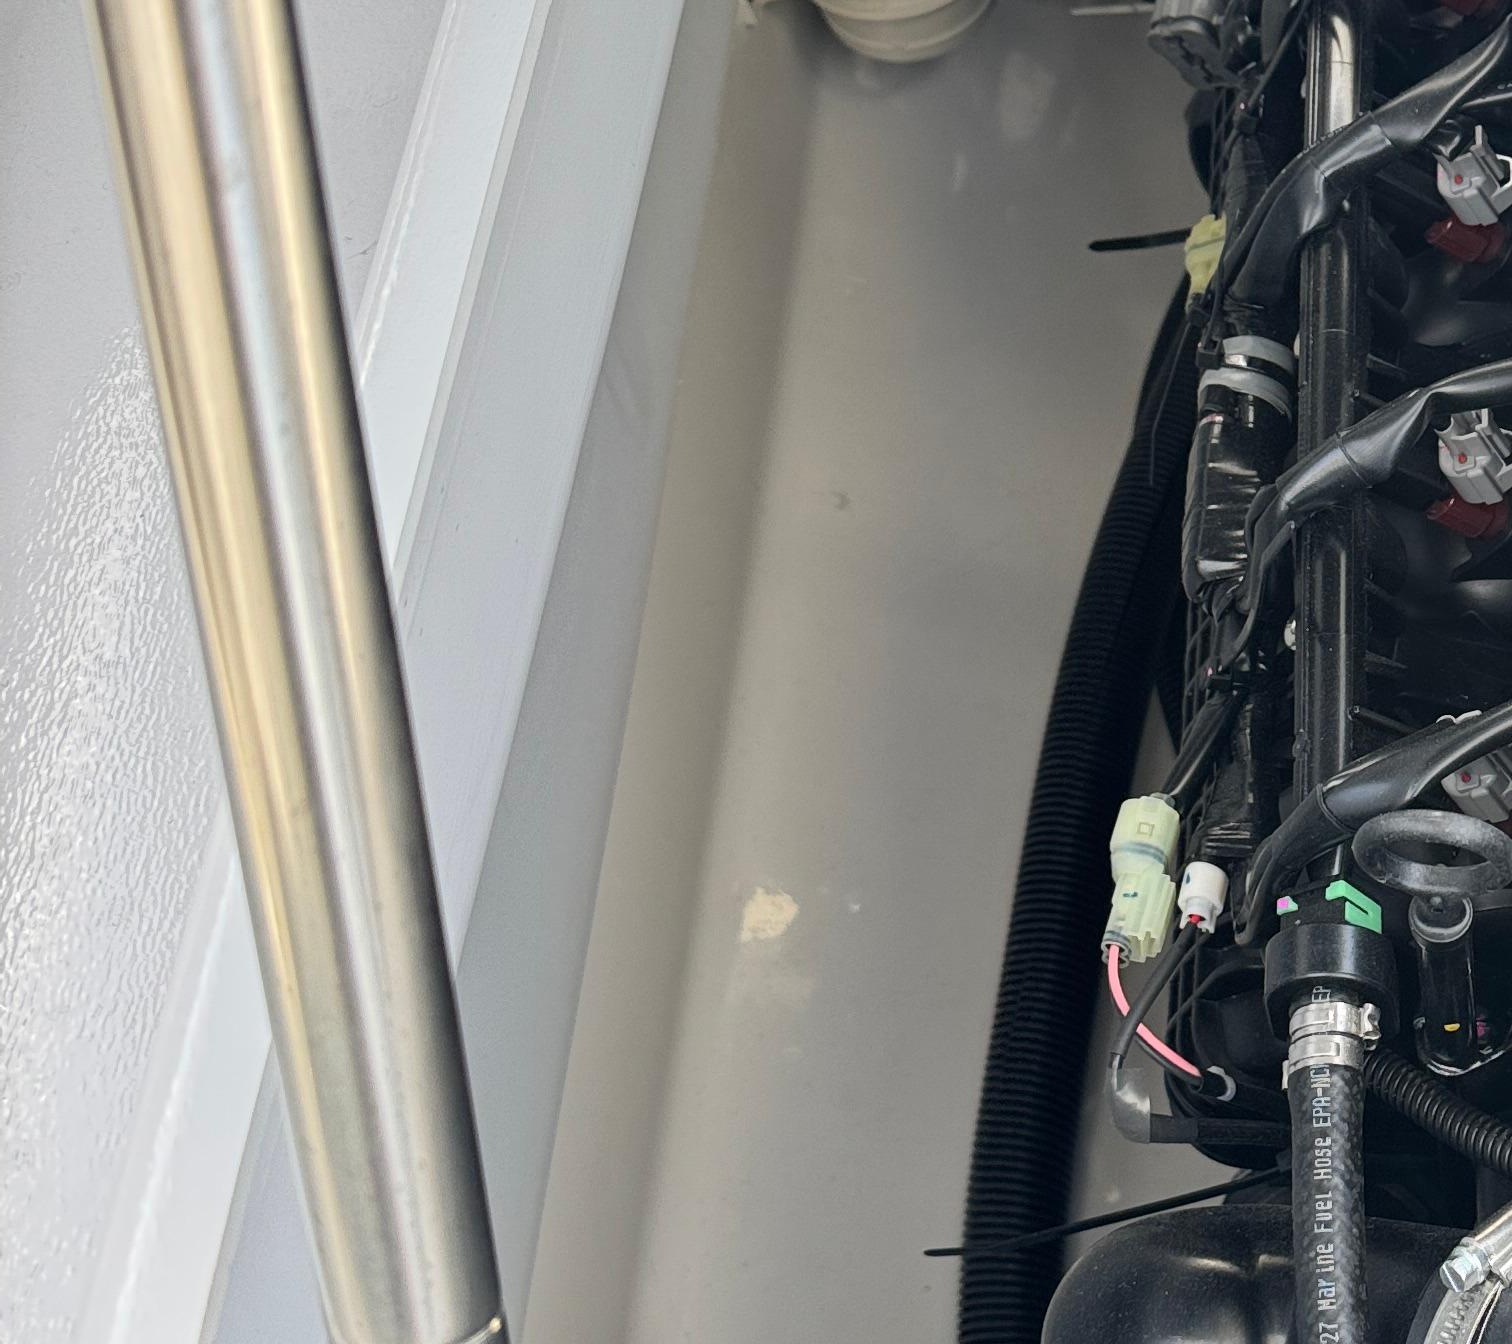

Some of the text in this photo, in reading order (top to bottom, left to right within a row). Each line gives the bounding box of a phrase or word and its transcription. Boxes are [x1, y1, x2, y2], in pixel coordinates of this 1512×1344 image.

[1312, 1136, 1333, 1180] Hose
[1313, 1191, 1334, 1233] Fuel
[1315, 1242, 1337, 1311] Marine
